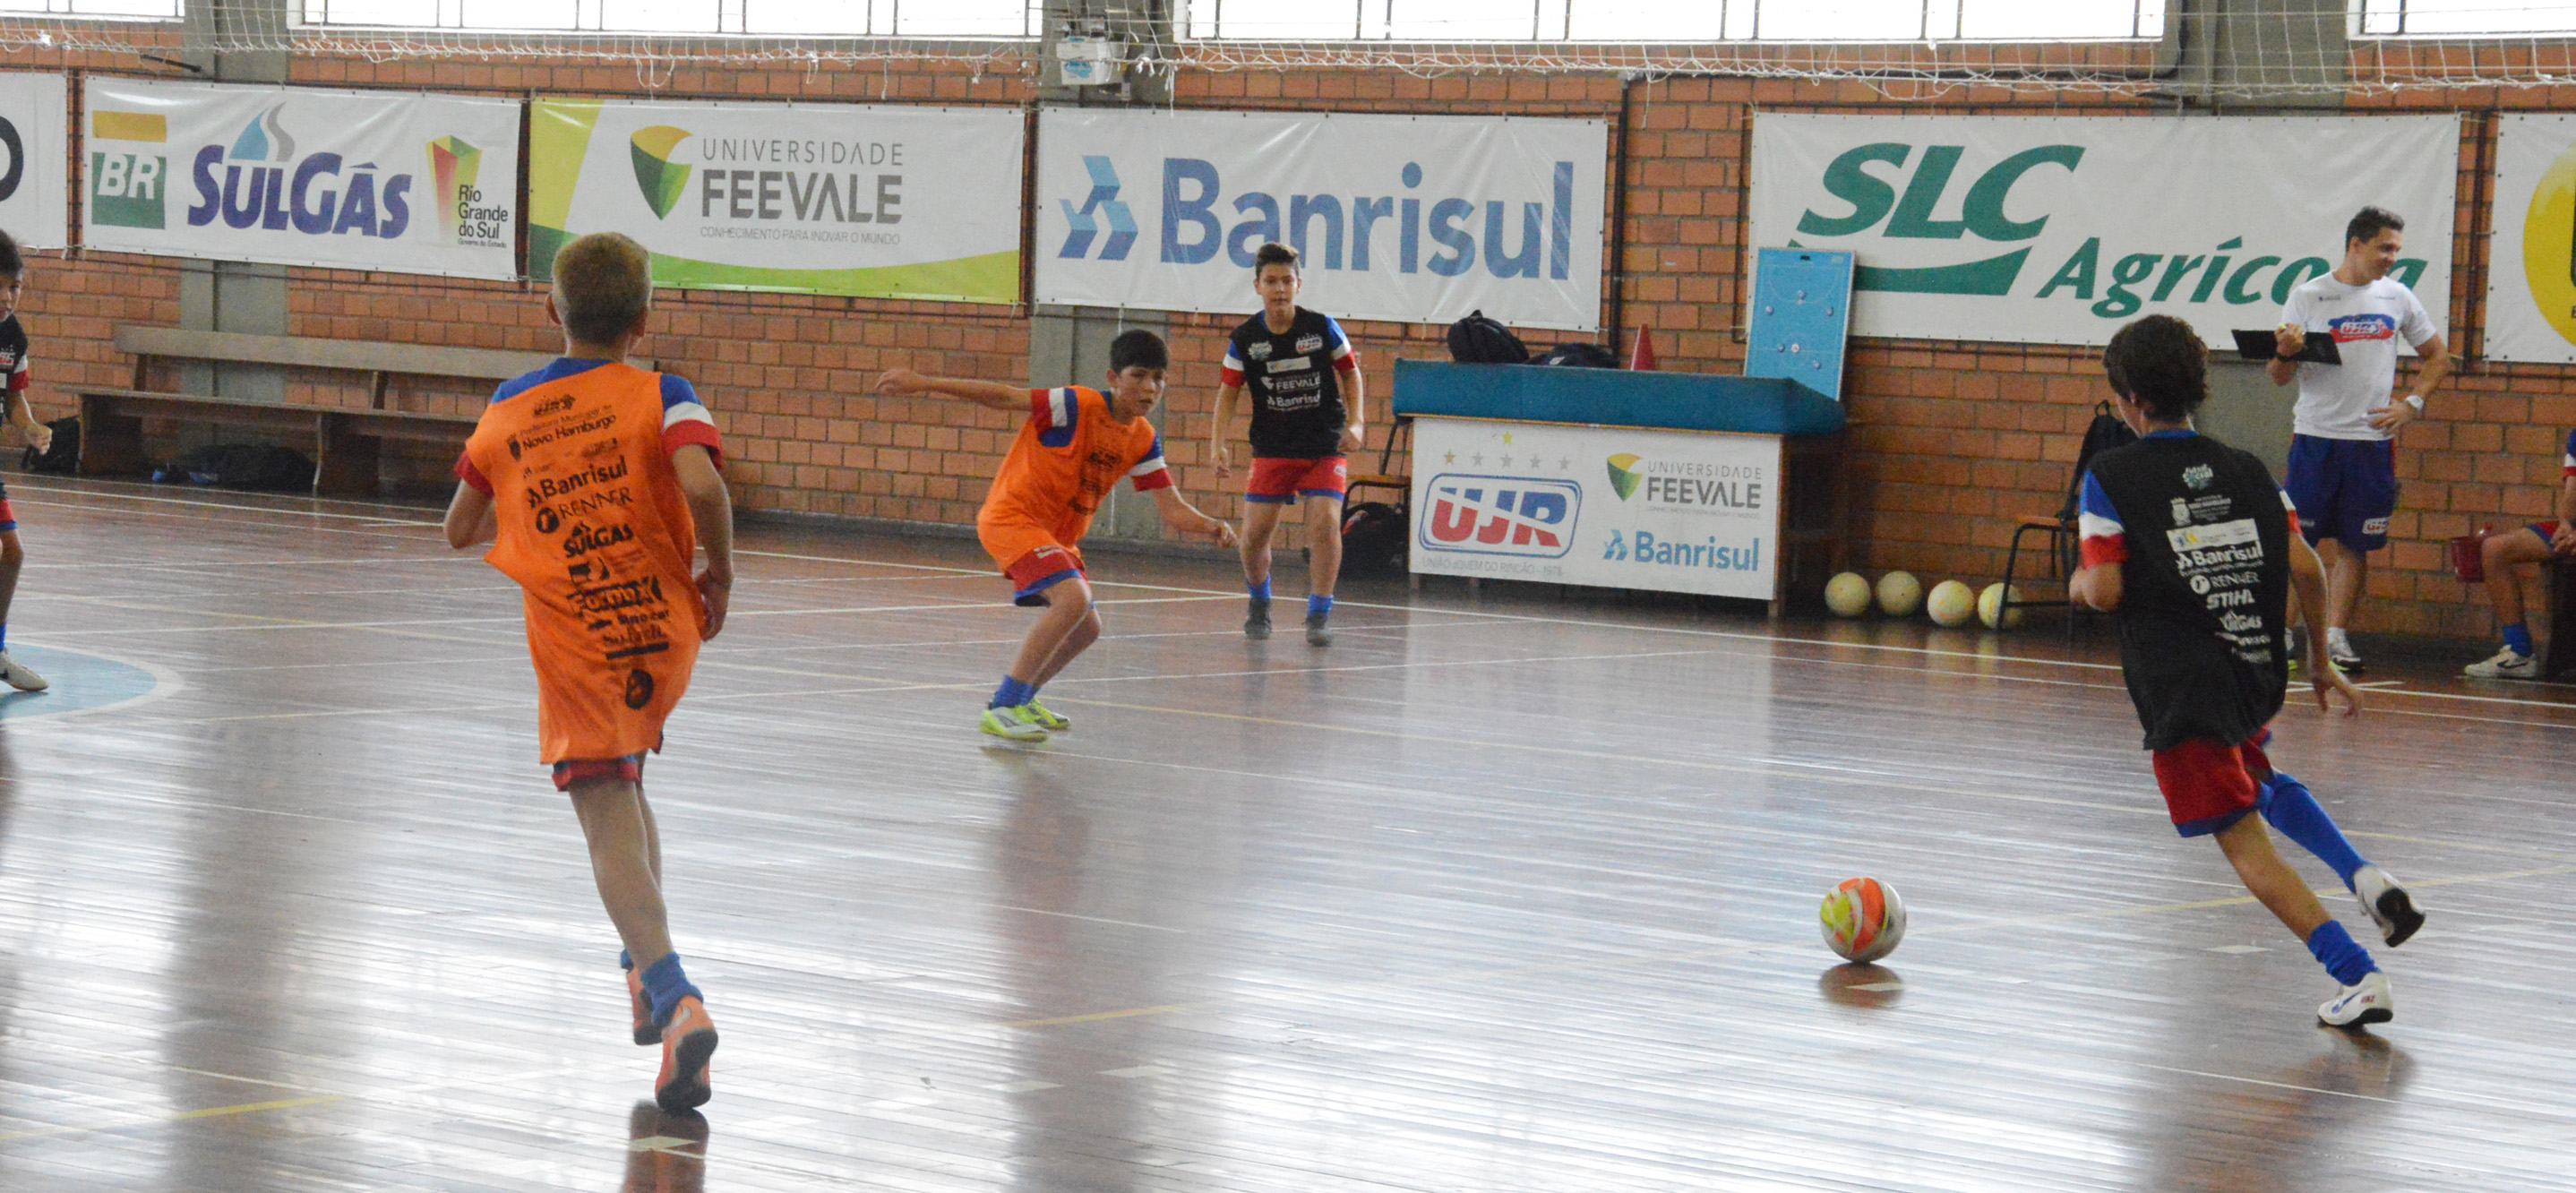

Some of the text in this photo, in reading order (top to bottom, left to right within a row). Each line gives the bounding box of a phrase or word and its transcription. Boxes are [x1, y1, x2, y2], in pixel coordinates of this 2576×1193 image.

[703, 138, 904, 167] UNIVERSIDADE
[97, 152, 159, 200] BR
[1796, 142, 2086, 242] SLC
[459, 184, 482, 202] Rio
[702, 168, 903, 225] FEEVALE
[458, 202, 509, 222] Grande
[1160, 157, 1574, 280] Banrisul
[458, 220, 500, 239] do Sul
[700, 226, 901, 245] CONHECIMENTO PARA INOVAR O MUNDO
[1275, 376, 1321, 391] FEEVALE
[523, 415, 617, 451] Novo Hamburgo
[539, 455, 629, 500] Banrisul
[1647, 460, 1763, 480] UNIVERSIDADE
[558, 486, 634, 519] RENNER
[1646, 476, 1762, 510] FEEVALE
[1430, 486, 1567, 547] UJR
[1635, 530, 1760, 571] Banrisul
[2191, 540, 2264, 566] Banrisul
[2205, 588, 2256, 610] STIHL
